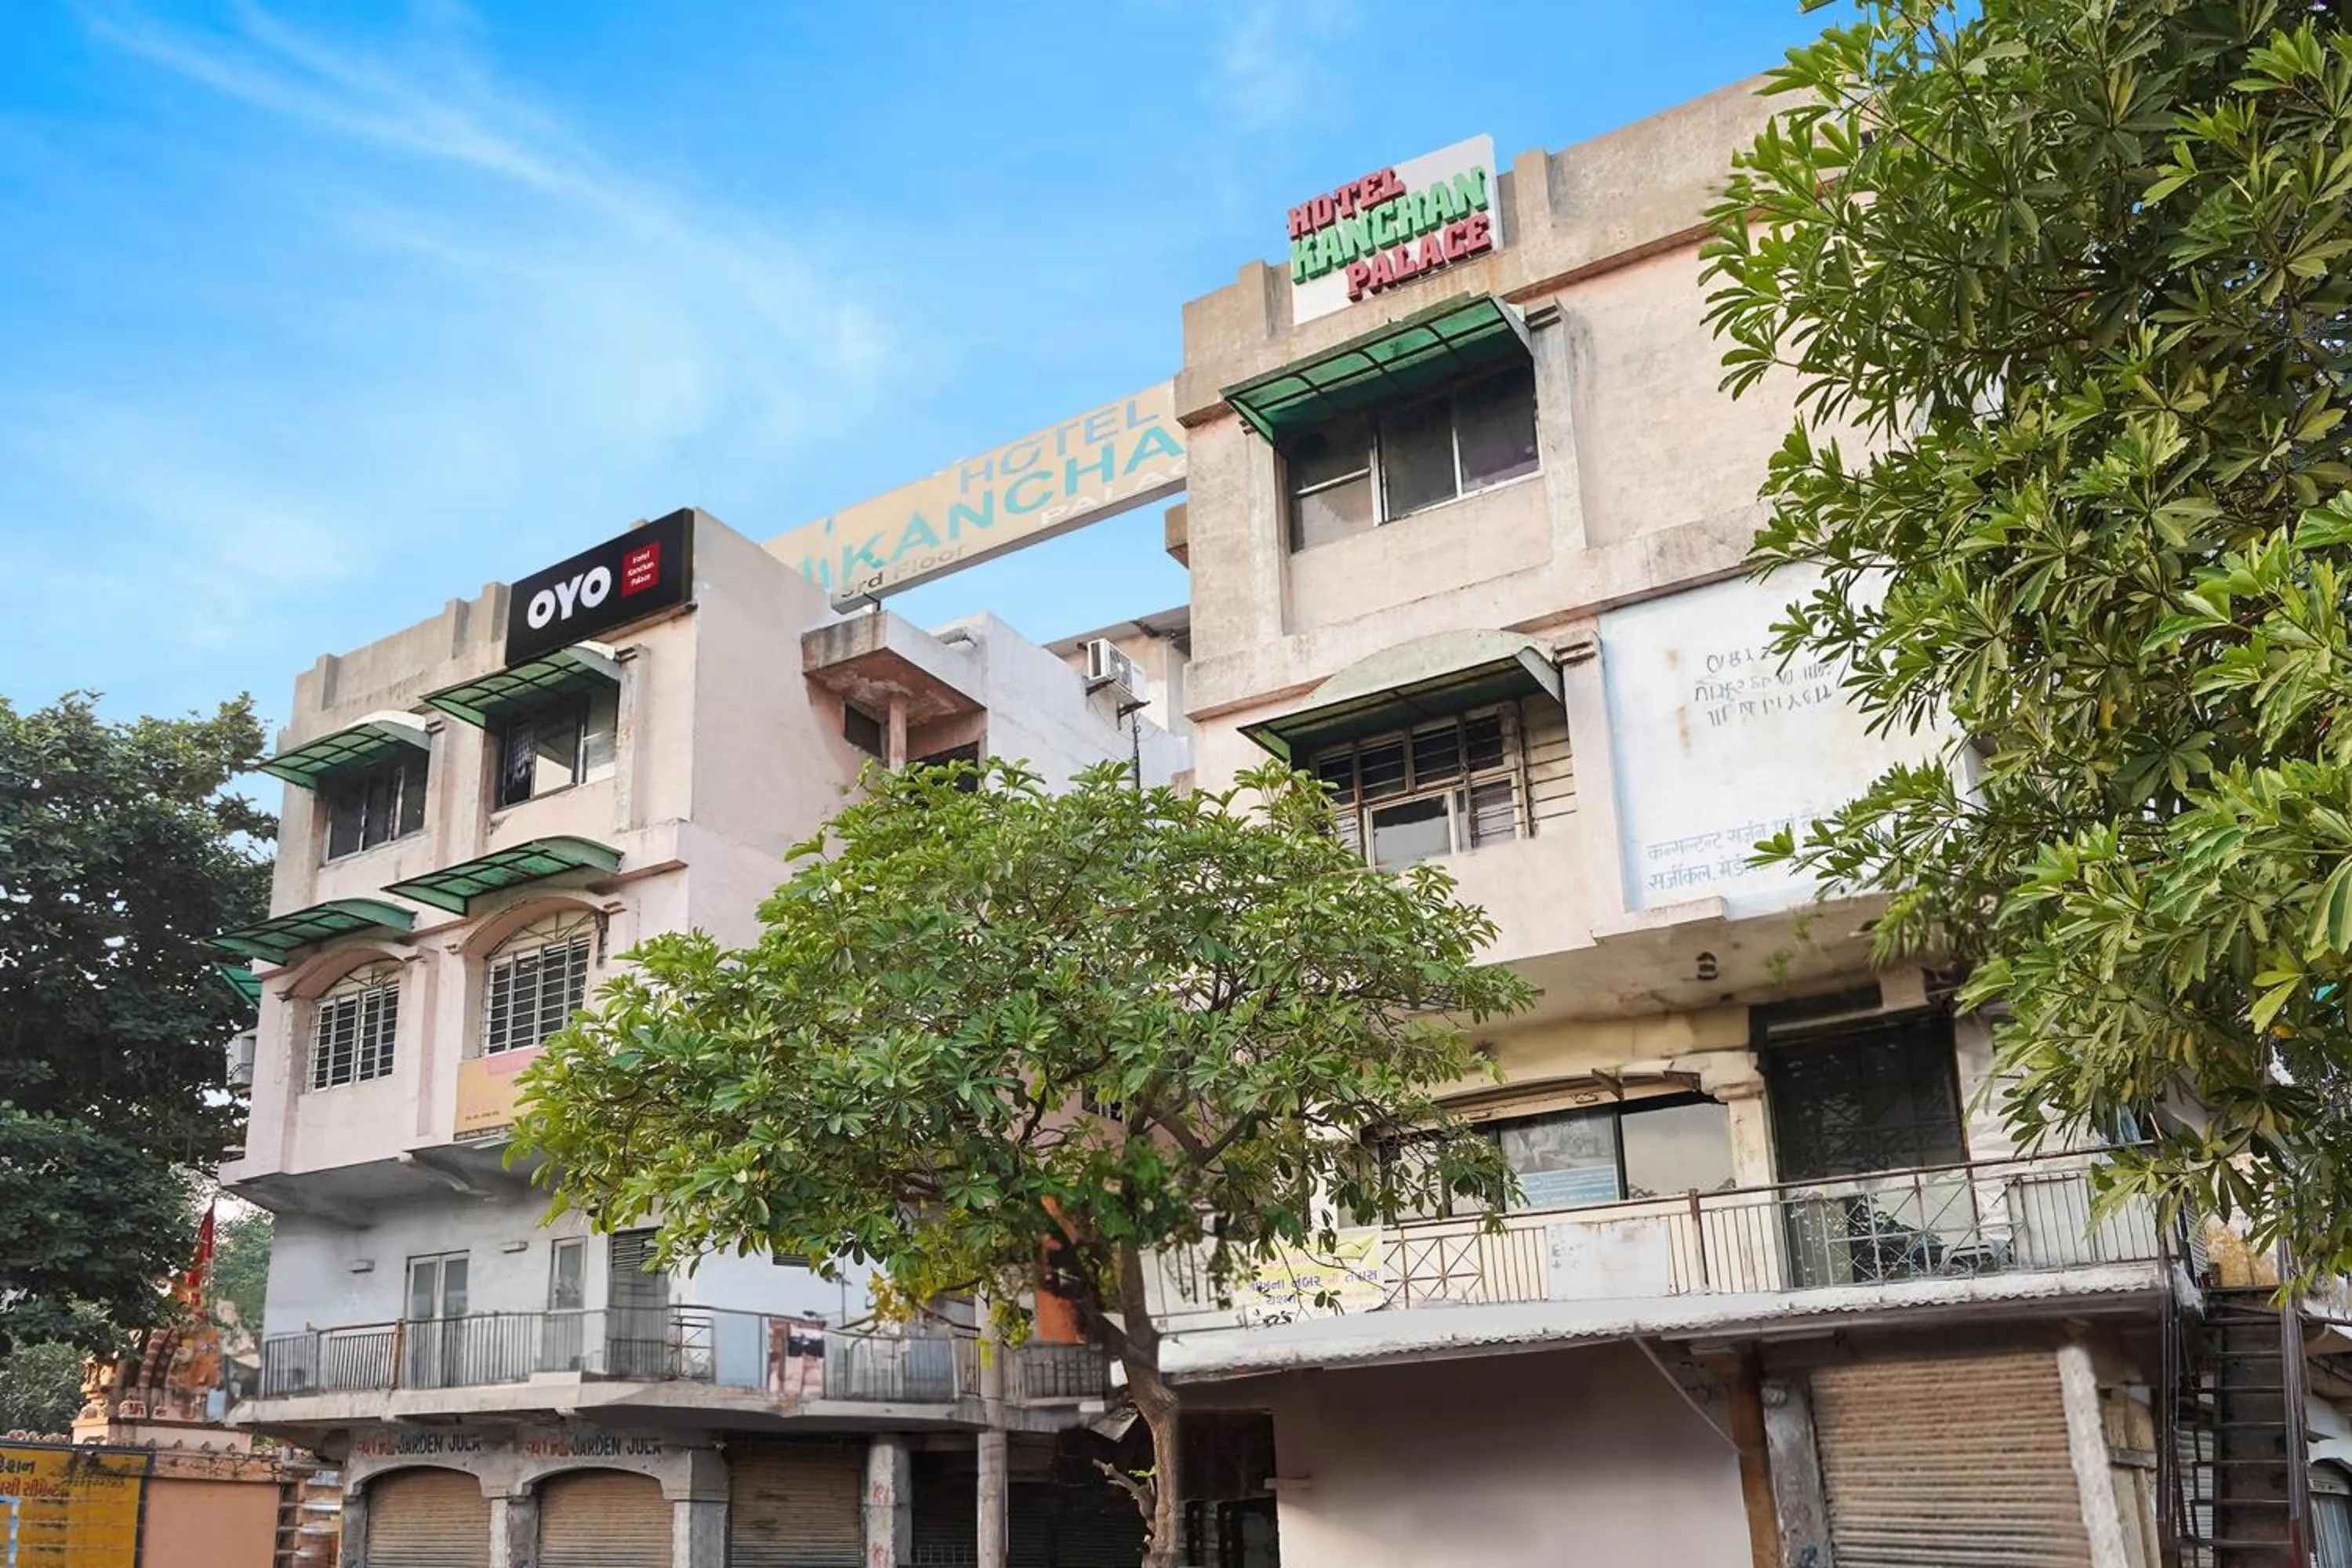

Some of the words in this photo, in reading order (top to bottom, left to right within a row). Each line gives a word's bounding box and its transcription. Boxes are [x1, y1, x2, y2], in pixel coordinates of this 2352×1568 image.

[1287, 167, 1406, 241] HOTEL
[1291, 165, 1489, 285] KANCHAN
[1345, 212, 1493, 303] PALACE
[959, 399, 1160, 495] HOTEL
[528, 565, 612, 630] OYO
